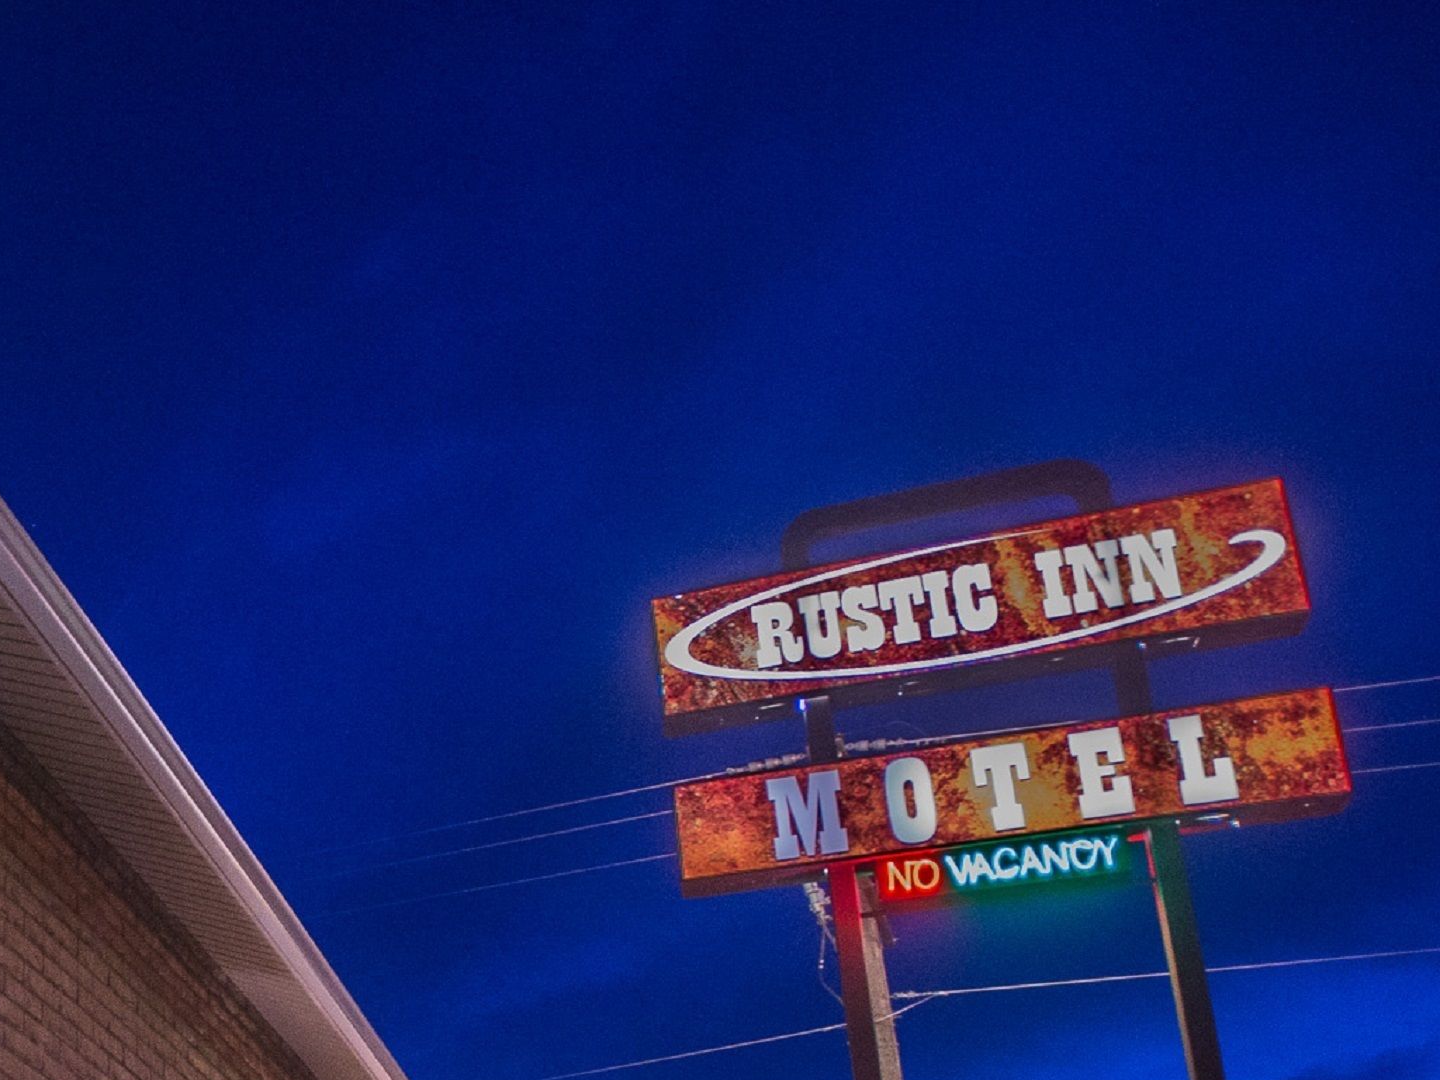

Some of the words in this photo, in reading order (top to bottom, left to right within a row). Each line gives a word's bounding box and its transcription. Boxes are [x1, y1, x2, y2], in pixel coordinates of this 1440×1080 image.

[750, 563, 998, 669] RUSTIC
[1035, 528, 1183, 620] INN
[765, 713, 1240, 861] MOTEL
[885, 859, 941, 894] NO
[944, 835, 1120, 888] VACANCY
